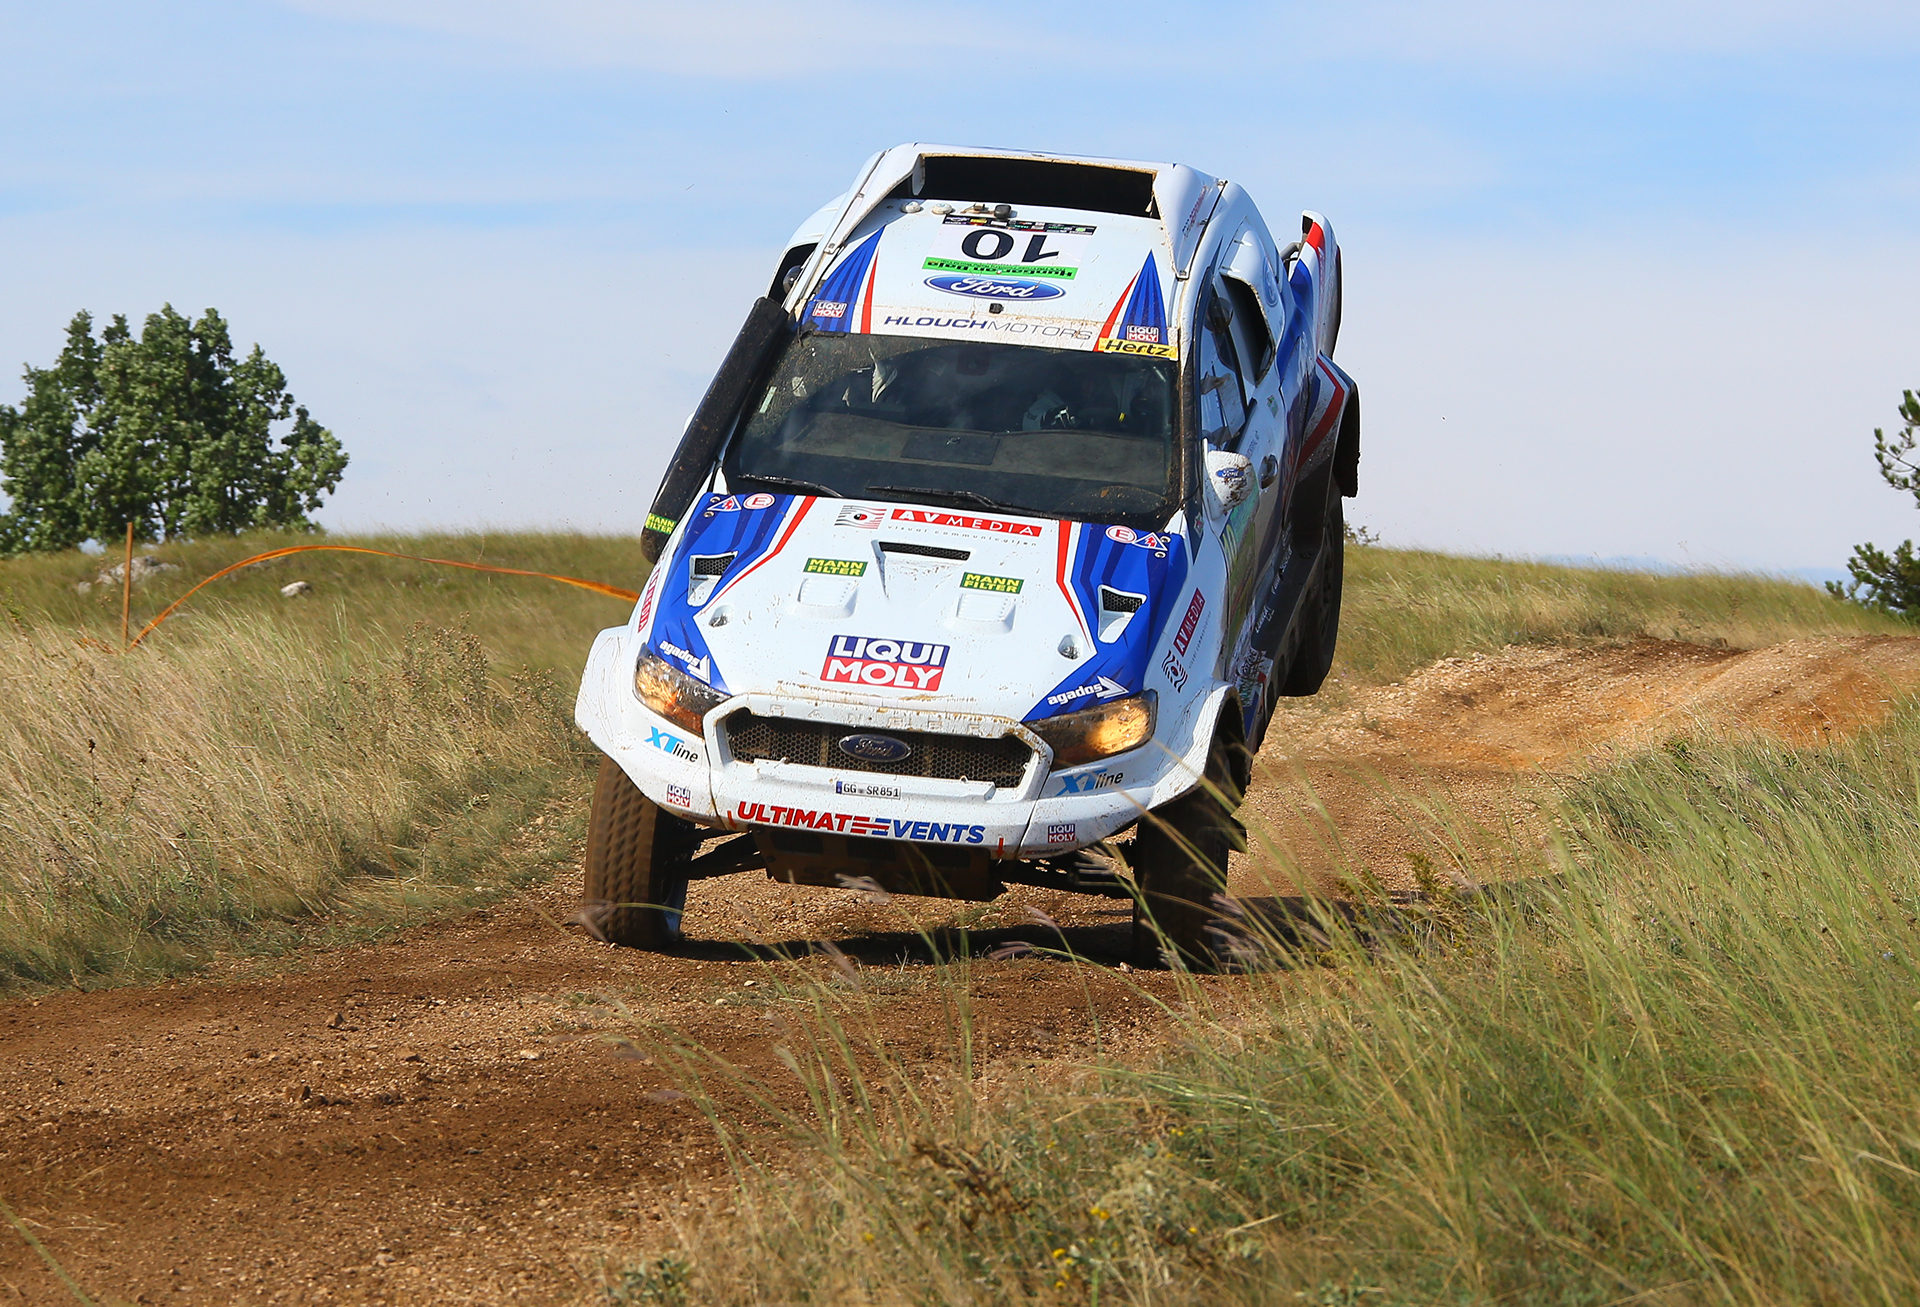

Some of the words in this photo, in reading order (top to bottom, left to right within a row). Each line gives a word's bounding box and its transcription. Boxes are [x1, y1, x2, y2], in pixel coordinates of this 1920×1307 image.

[962, 229, 1059, 263] 10
[950, 278, 1035, 298] Ford
[816, 301, 846, 310] LIQUI
[814, 309, 843, 317] MOLY
[1128, 325, 1158, 335] LIQUI
[1128, 333, 1158, 342] MOLY
[1105, 340, 1171, 357] Hertz
[810, 558, 864, 569] MANN
[807, 565, 861, 576] FILTER
[963, 580, 1018, 593] FILTER
[966, 573, 1020, 587] MANN
[659, 641, 702, 667] agados
[833, 635, 945, 666] LIQUI
[826, 659, 942, 689] MOLY
[1047, 683, 1104, 706] agados
[843, 783, 857, 794] GG
[667, 793, 690, 807] MOLY
[1049, 824, 1074, 834] LIQUI
[1049, 833, 1075, 843] MOLY
